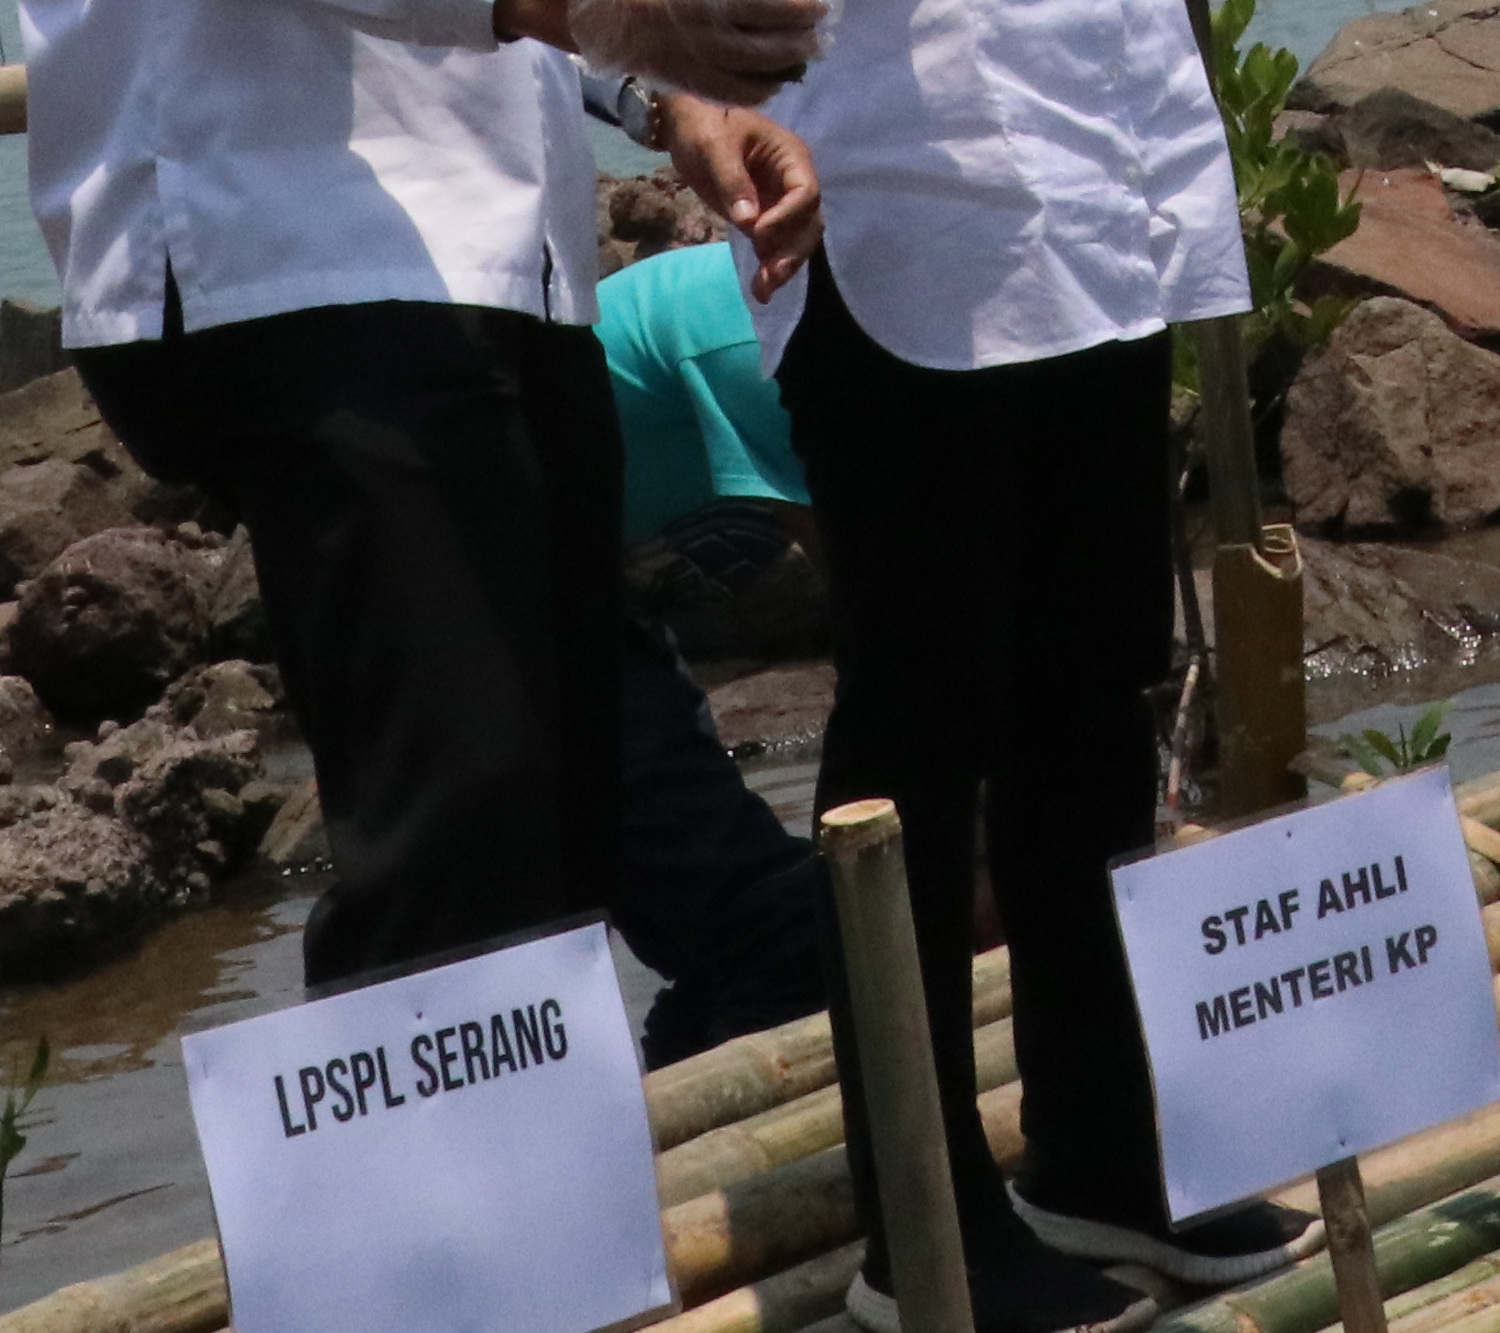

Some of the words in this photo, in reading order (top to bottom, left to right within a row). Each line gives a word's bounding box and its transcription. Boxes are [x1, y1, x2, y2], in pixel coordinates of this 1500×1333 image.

[1200, 888, 1300, 956] STAF
[1316, 855, 1408, 919] AHLI
[1194, 945, 1375, 1041] MENTERI
[1386, 923, 1438, 974] KP
[273, 1046, 406, 1139] LPSPL
[411, 997, 569, 1099] SERANG
